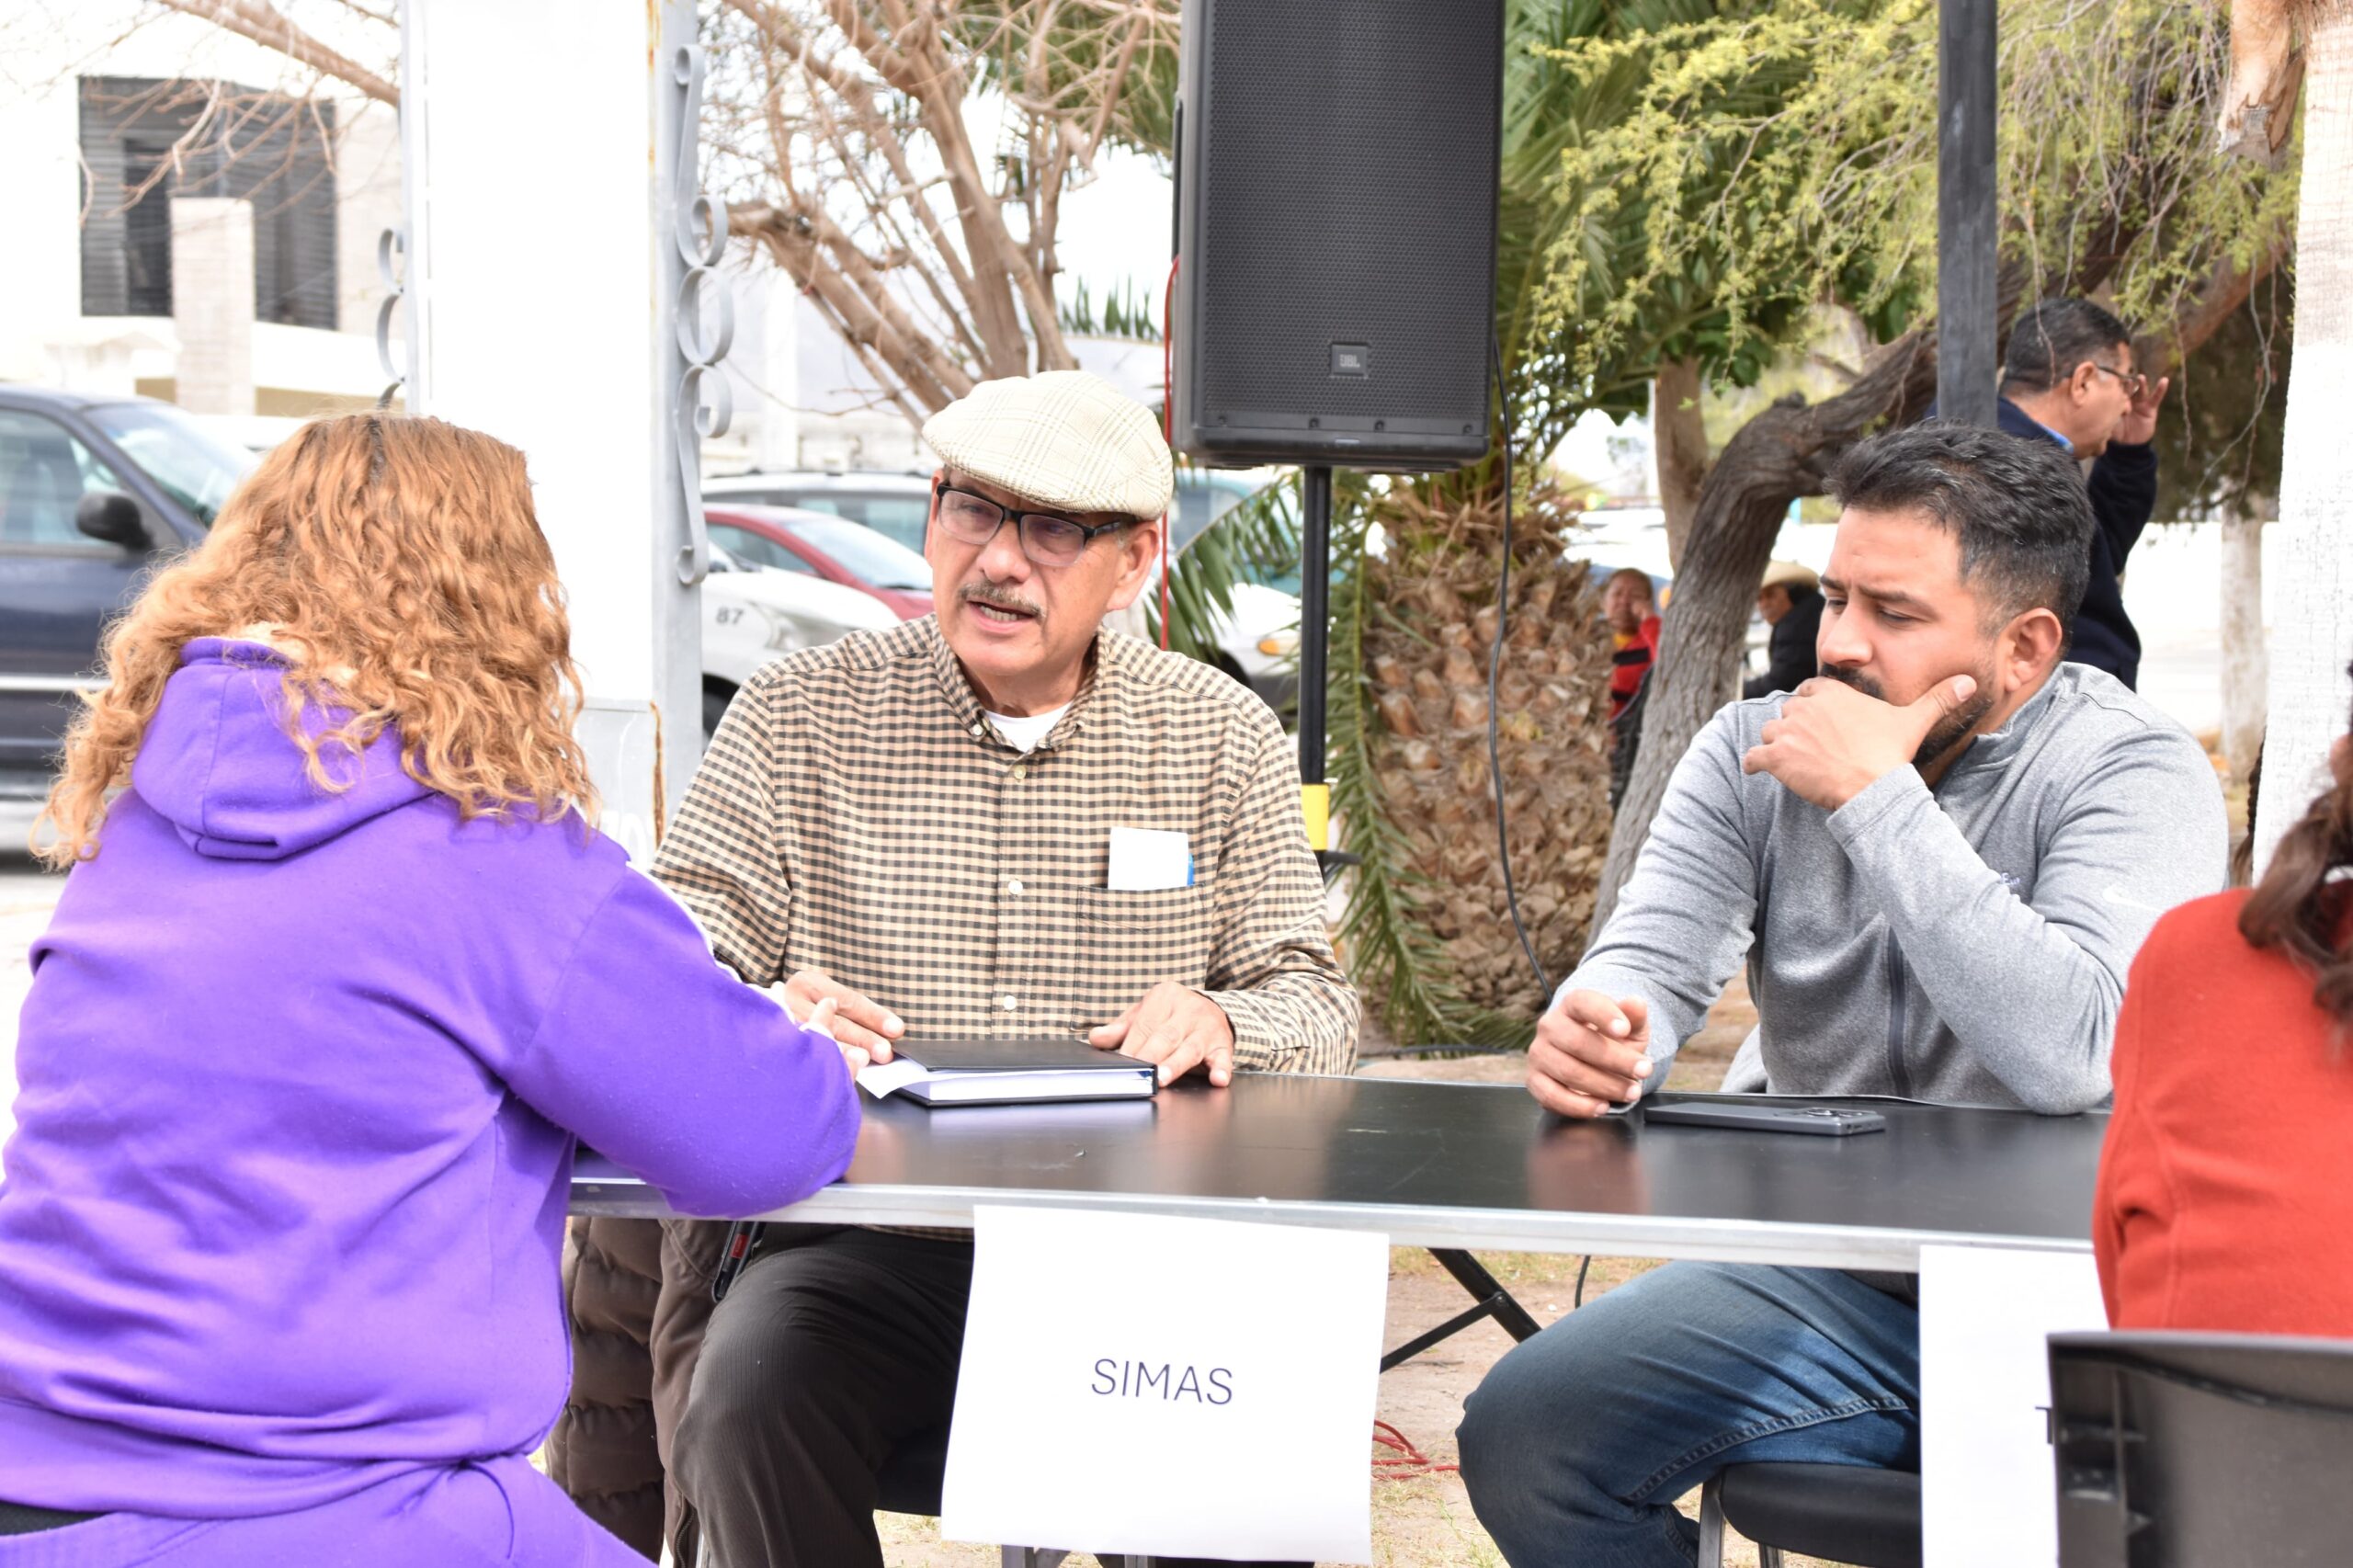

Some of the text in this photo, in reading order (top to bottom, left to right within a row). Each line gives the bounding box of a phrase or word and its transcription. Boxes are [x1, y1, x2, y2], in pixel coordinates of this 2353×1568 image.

[1339, 353, 1360, 368] JBL
[716, 606, 745, 626] 87
[1091, 1358, 1233, 1405] SIMAS
